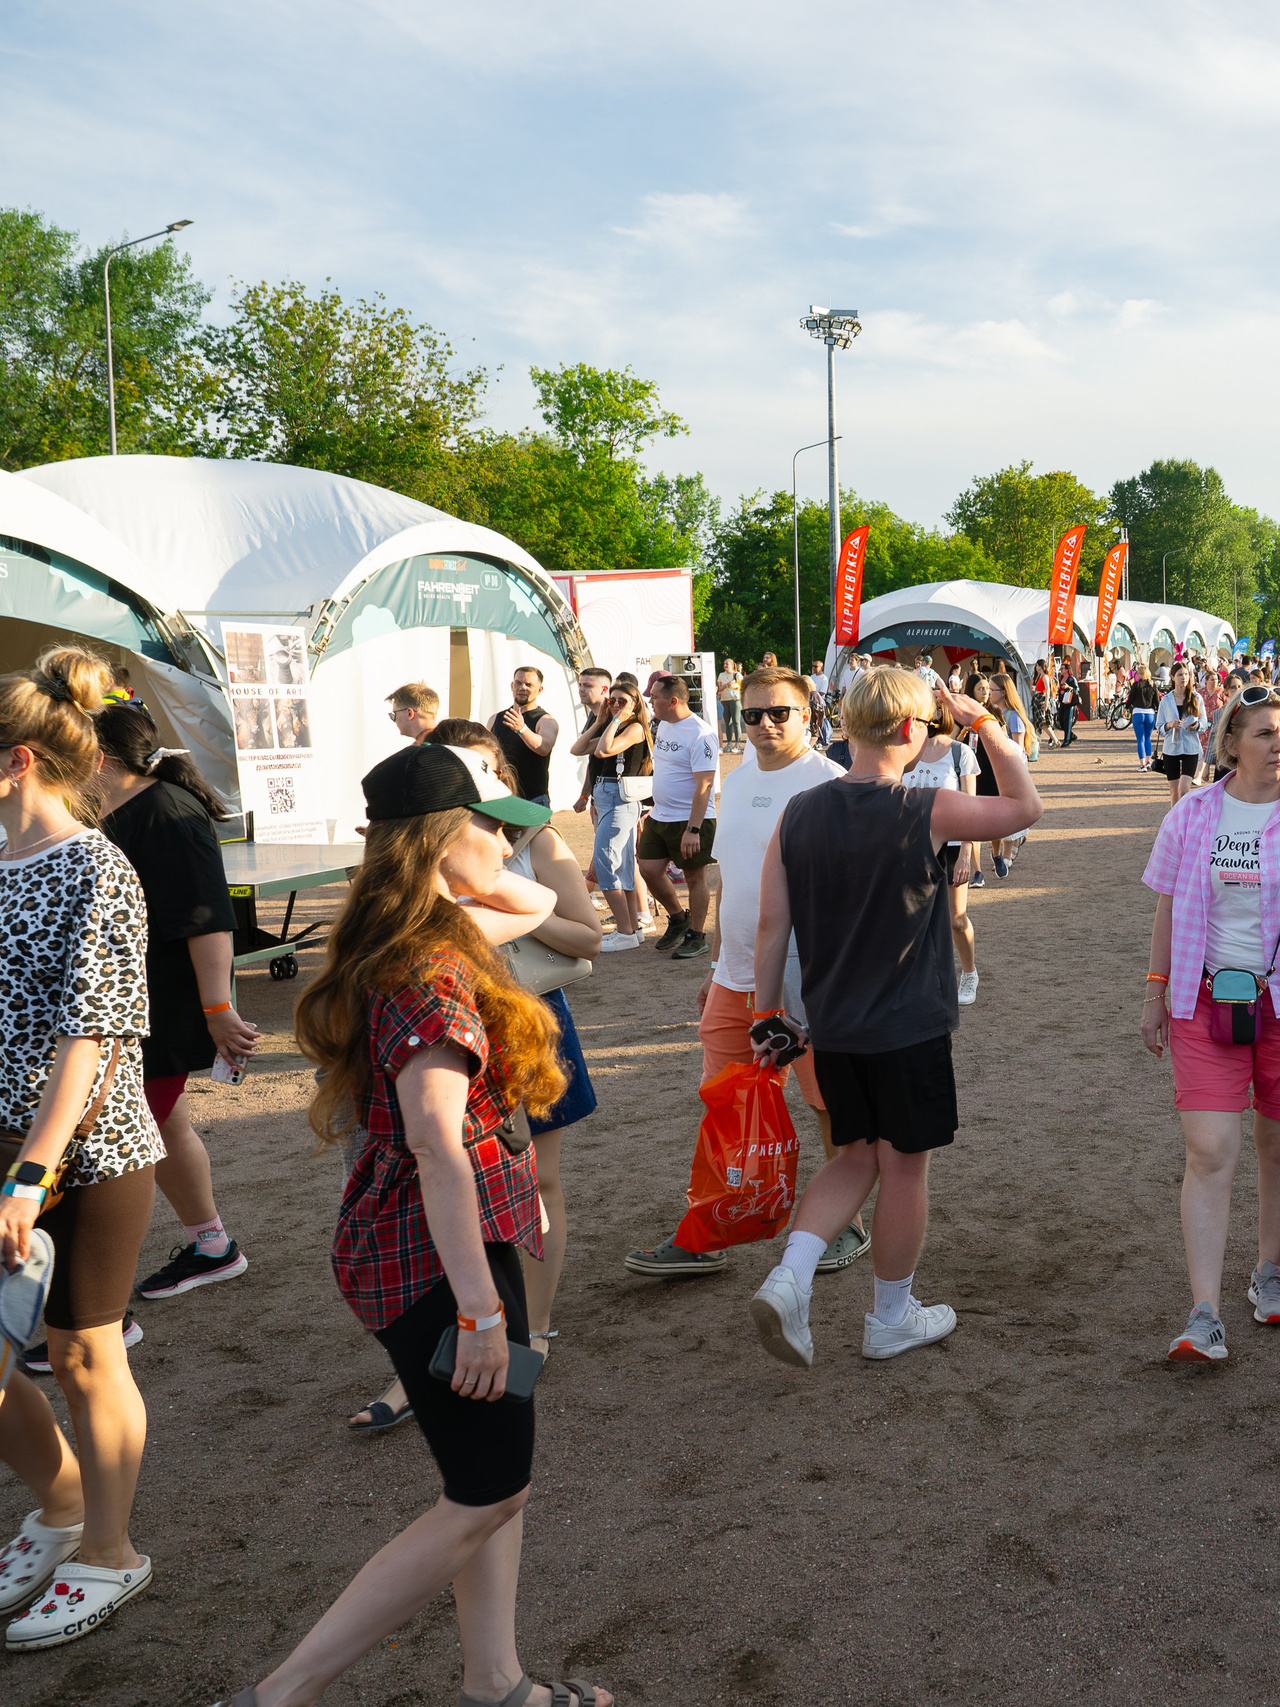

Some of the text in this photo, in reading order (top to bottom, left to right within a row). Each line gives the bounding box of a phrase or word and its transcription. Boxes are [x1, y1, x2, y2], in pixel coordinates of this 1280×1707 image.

[417, 580, 480, 595] FAHRENHEIT
[841, 550, 858, 635] ALPINEBIKE
[1055, 549, 1075, 633] ALPINEBIKE
[907, 628, 951, 636] ALPINEBIKE
[1215, 834, 1250, 857] Deep
[1210, 852, 1260, 869] Seawar
[1224, 872, 1247, 880] OCEAN
[736, 1138, 799, 1157] PNEBKE
[63, 1600, 114, 1636] crocs
